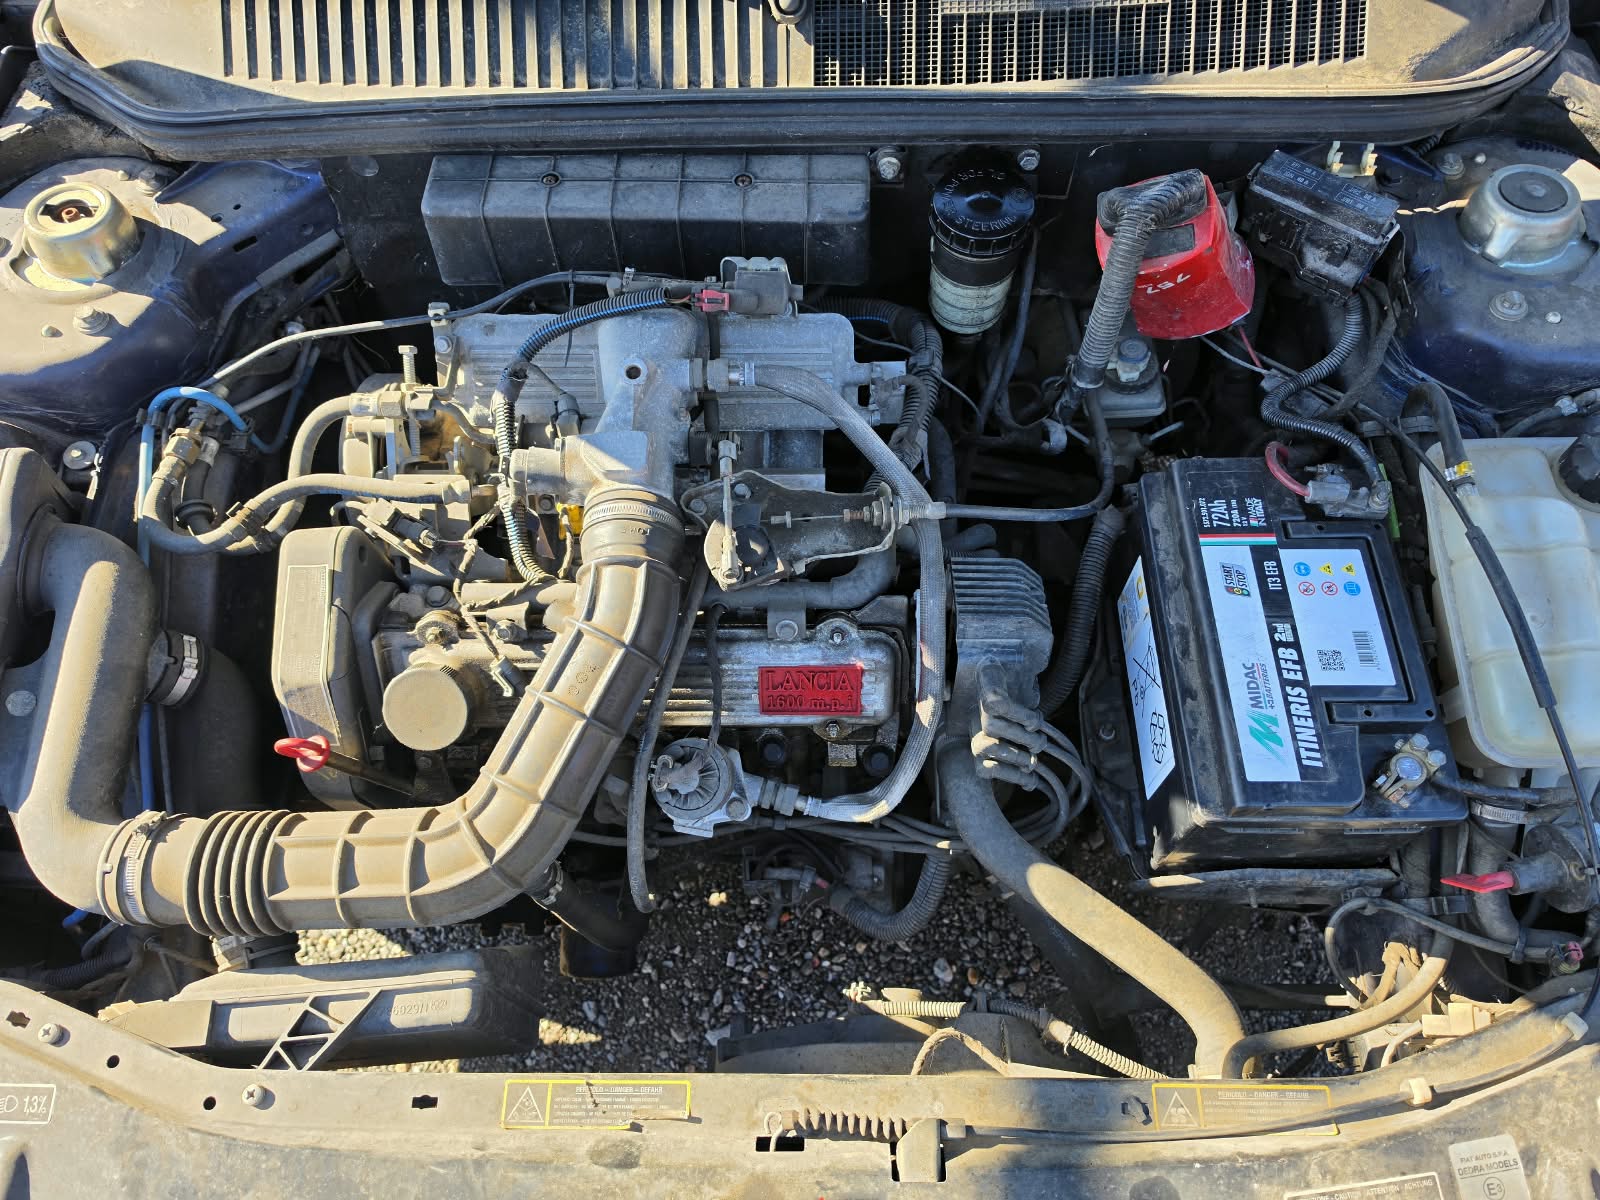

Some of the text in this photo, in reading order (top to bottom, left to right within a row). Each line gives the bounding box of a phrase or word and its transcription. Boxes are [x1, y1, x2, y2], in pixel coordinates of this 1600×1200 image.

[955, 215, 1016, 231] STEERING
[1208, 499, 1231, 527] 72Ah
[1245, 497, 1255, 518] MADE
[1253, 497, 1265, 517] ITALY
[1231, 510, 1241, 527] 720A
[1222, 565, 1235, 587] START
[1235, 570, 1248, 588] STOP
[1264, 561, 1282, 590] IT3 EFB
[1272, 623, 1286, 642] 2nd
[1277, 647, 1304, 681] EFB
[766, 669, 854, 692] LANCIA
[1242, 662, 1264, 710] MIDAC
[1260, 663, 1273, 699] BATTERIES
[767, 694, 805, 710] 1600
[1286, 685, 1323, 768] ITINERIS
[1457, 1157, 1519, 1176] DEDRA MODELS
